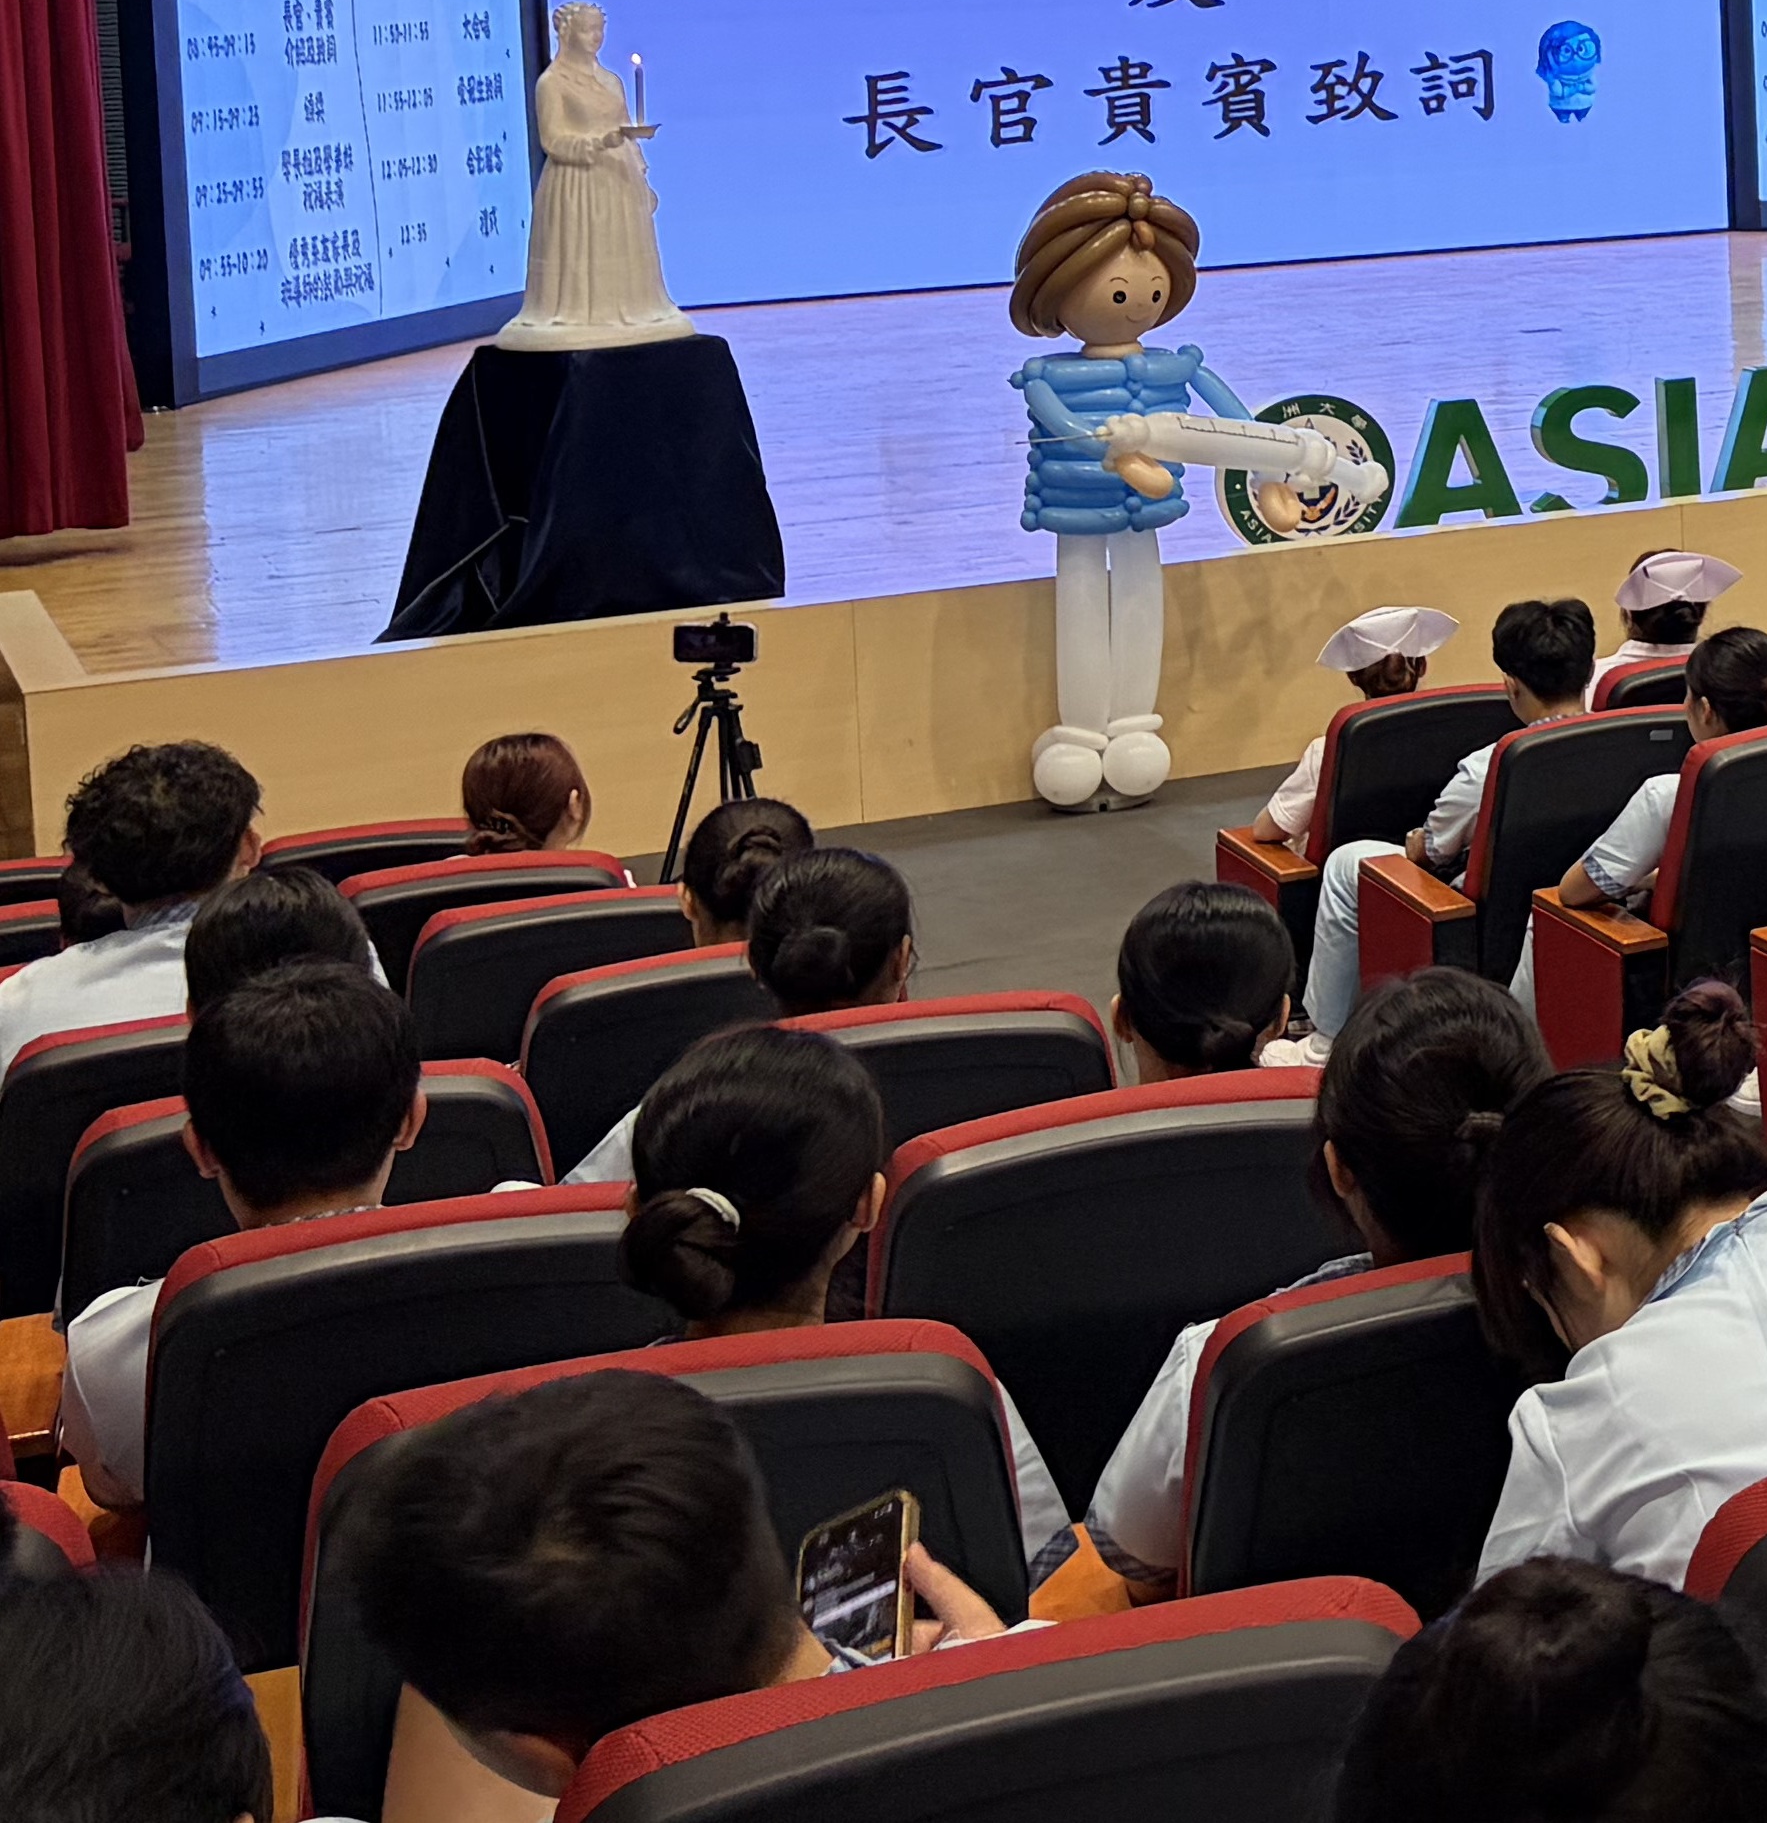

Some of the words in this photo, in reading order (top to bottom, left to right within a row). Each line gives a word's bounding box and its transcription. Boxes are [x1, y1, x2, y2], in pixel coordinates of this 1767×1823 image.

[841, 45, 1499, 161] 長官貴賓致詞
[1239, 509, 1273, 544] ASIA
